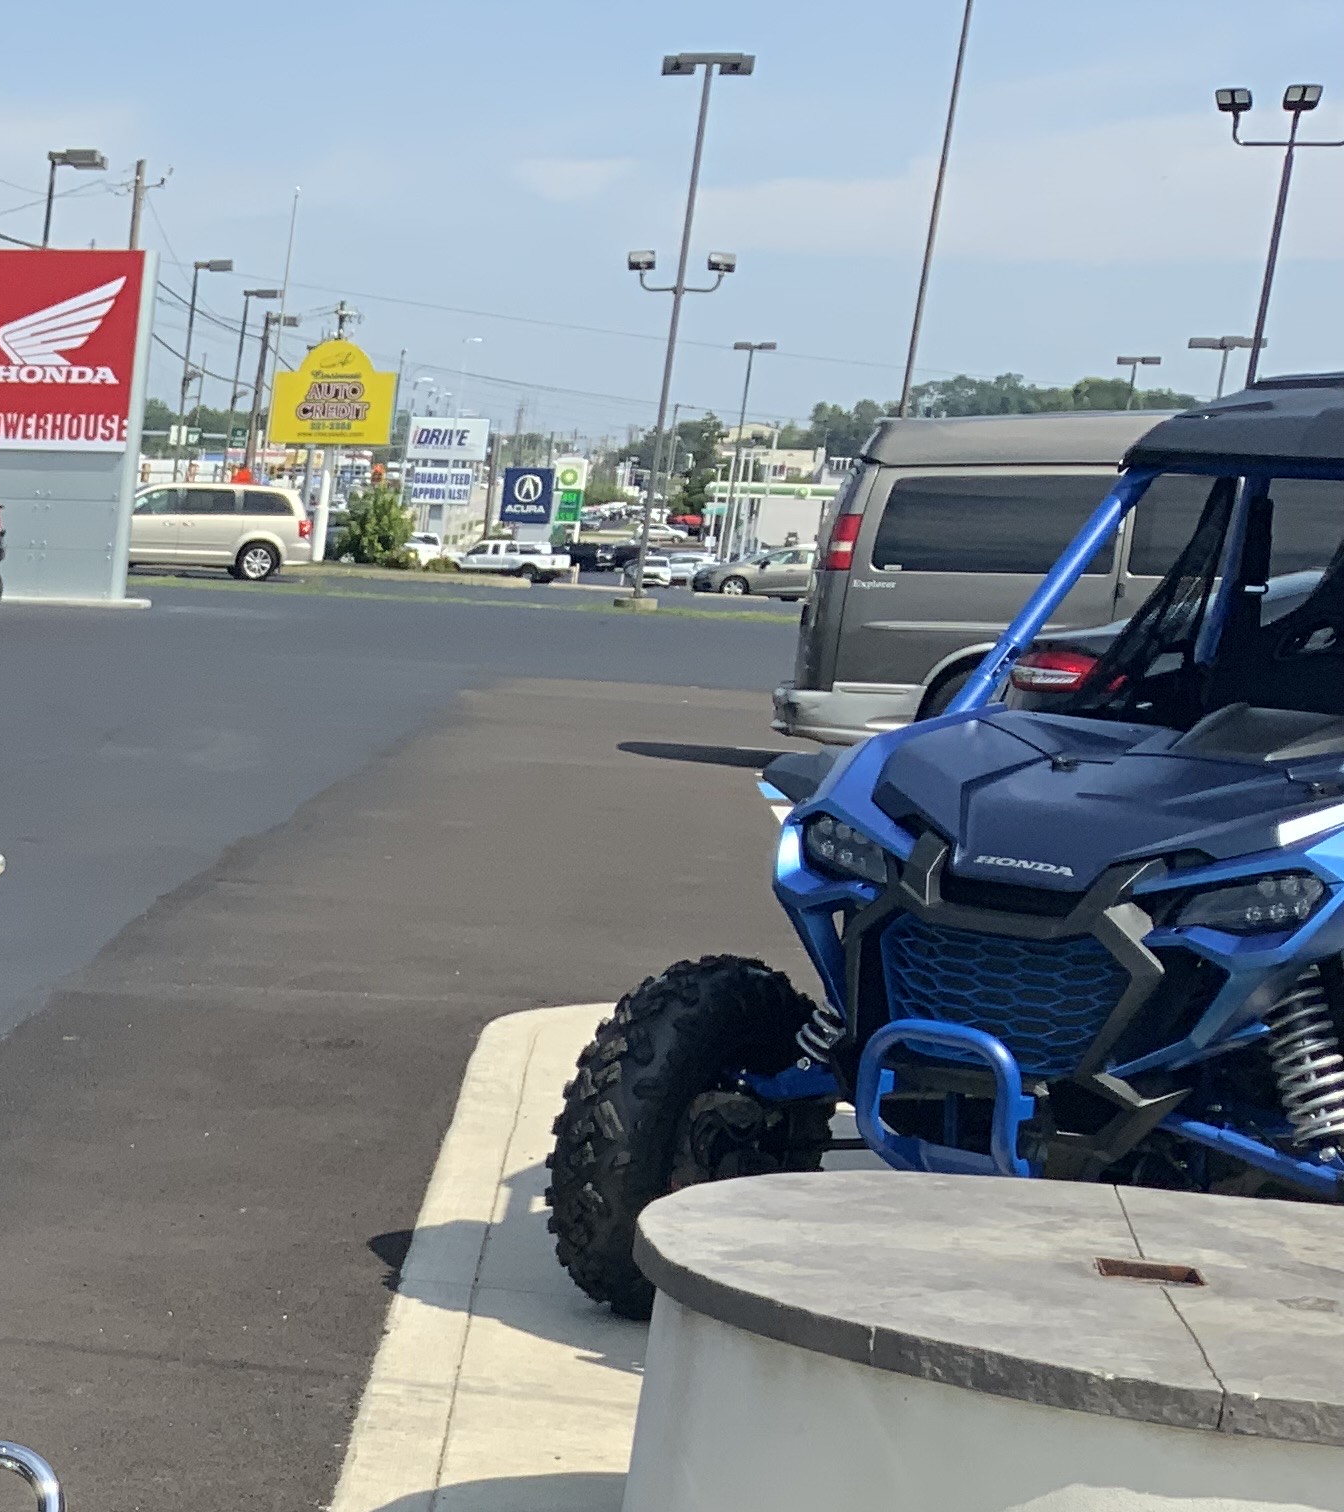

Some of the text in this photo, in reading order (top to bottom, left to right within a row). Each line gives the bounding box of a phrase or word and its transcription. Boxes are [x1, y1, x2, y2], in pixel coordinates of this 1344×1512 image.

[306, 382, 364, 400] AUTO
[296, 401, 370, 420] CREDIT
[505, 504, 546, 514] ACURA
[853, 579, 896, 590] Explorer
[973, 855, 1074, 877] HONDA
